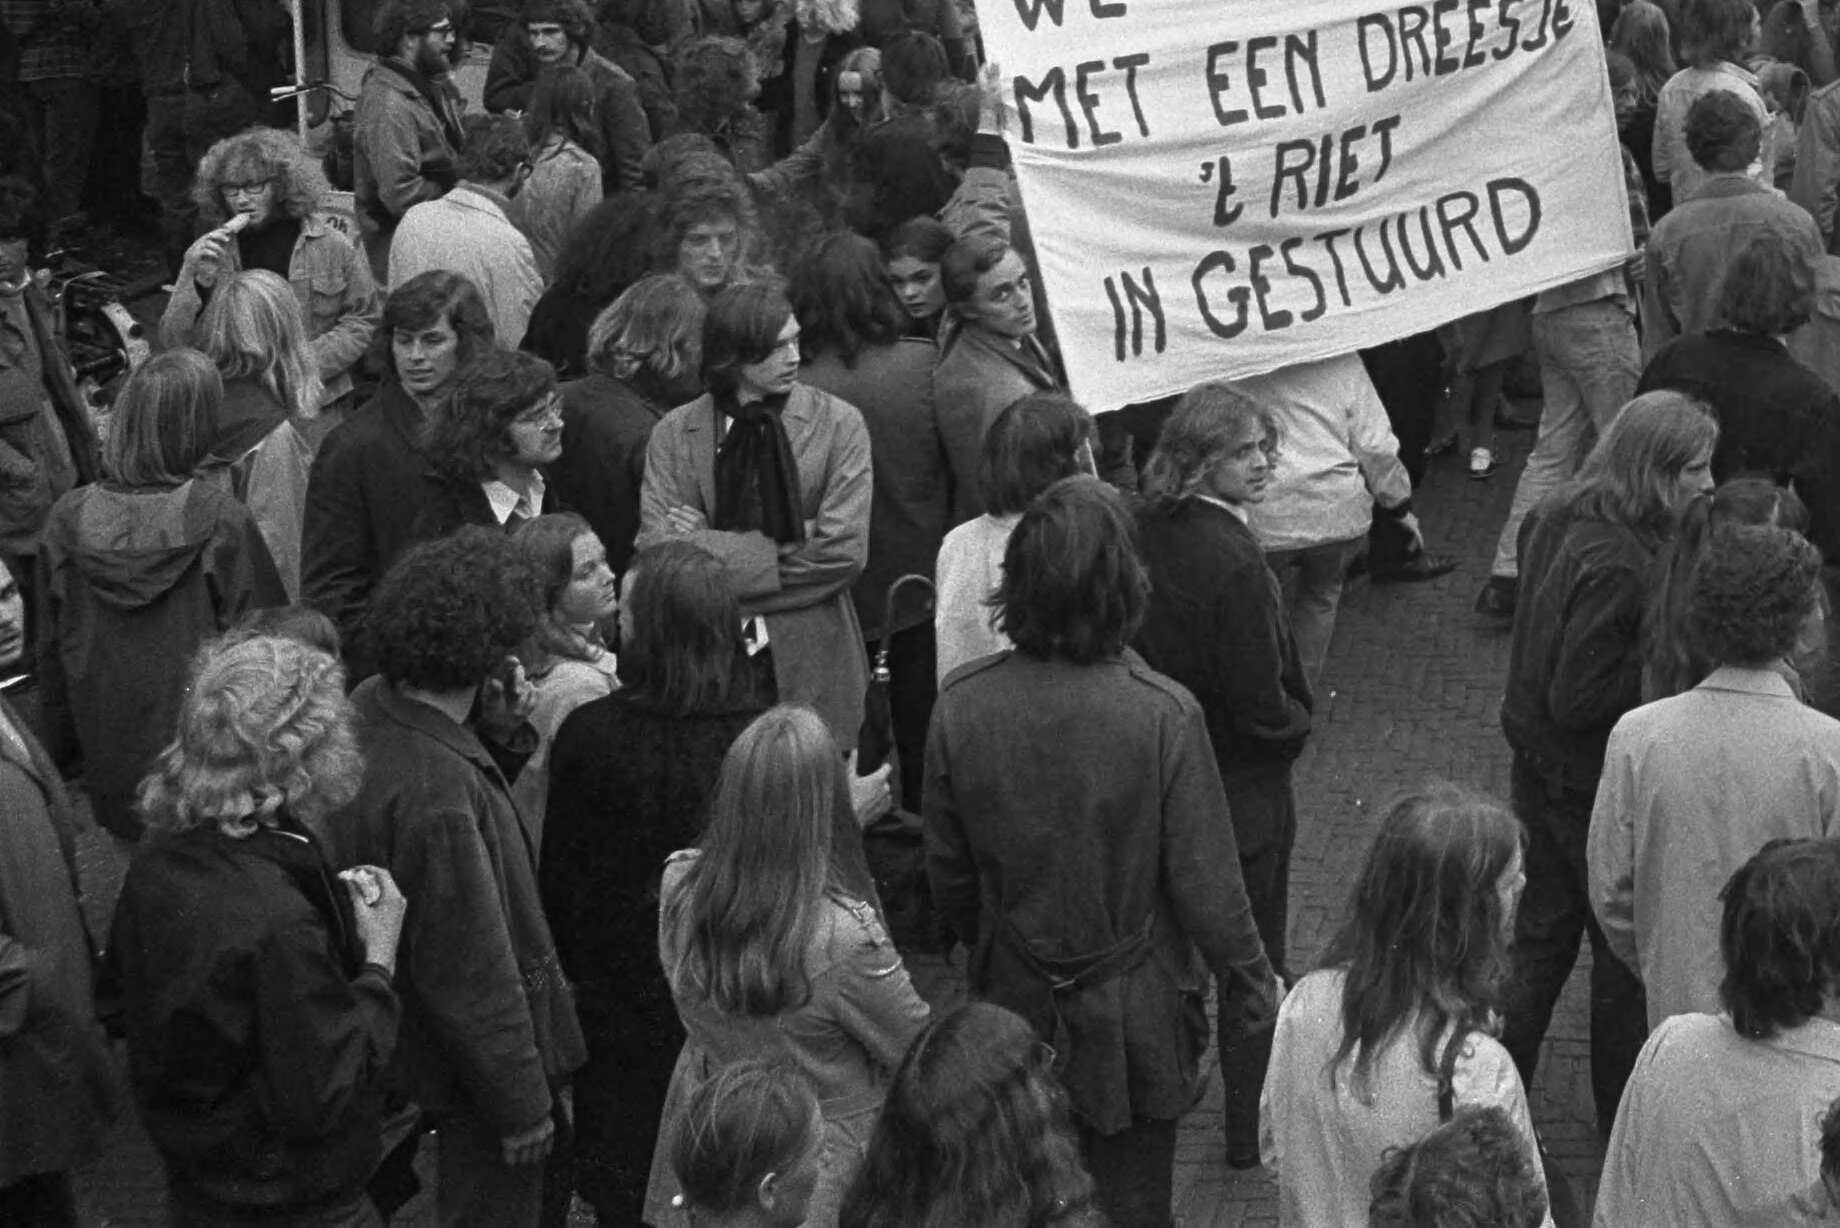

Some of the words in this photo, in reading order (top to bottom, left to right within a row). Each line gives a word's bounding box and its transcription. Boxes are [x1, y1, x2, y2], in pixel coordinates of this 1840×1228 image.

[1012, 53, 1150, 149] MET
[1206, 29, 1327, 127] EEN
[1269, 114, 1402, 218] RIET
[1104, 267, 1167, 362] IN
[1190, 176, 1543, 339] GESTUURD
